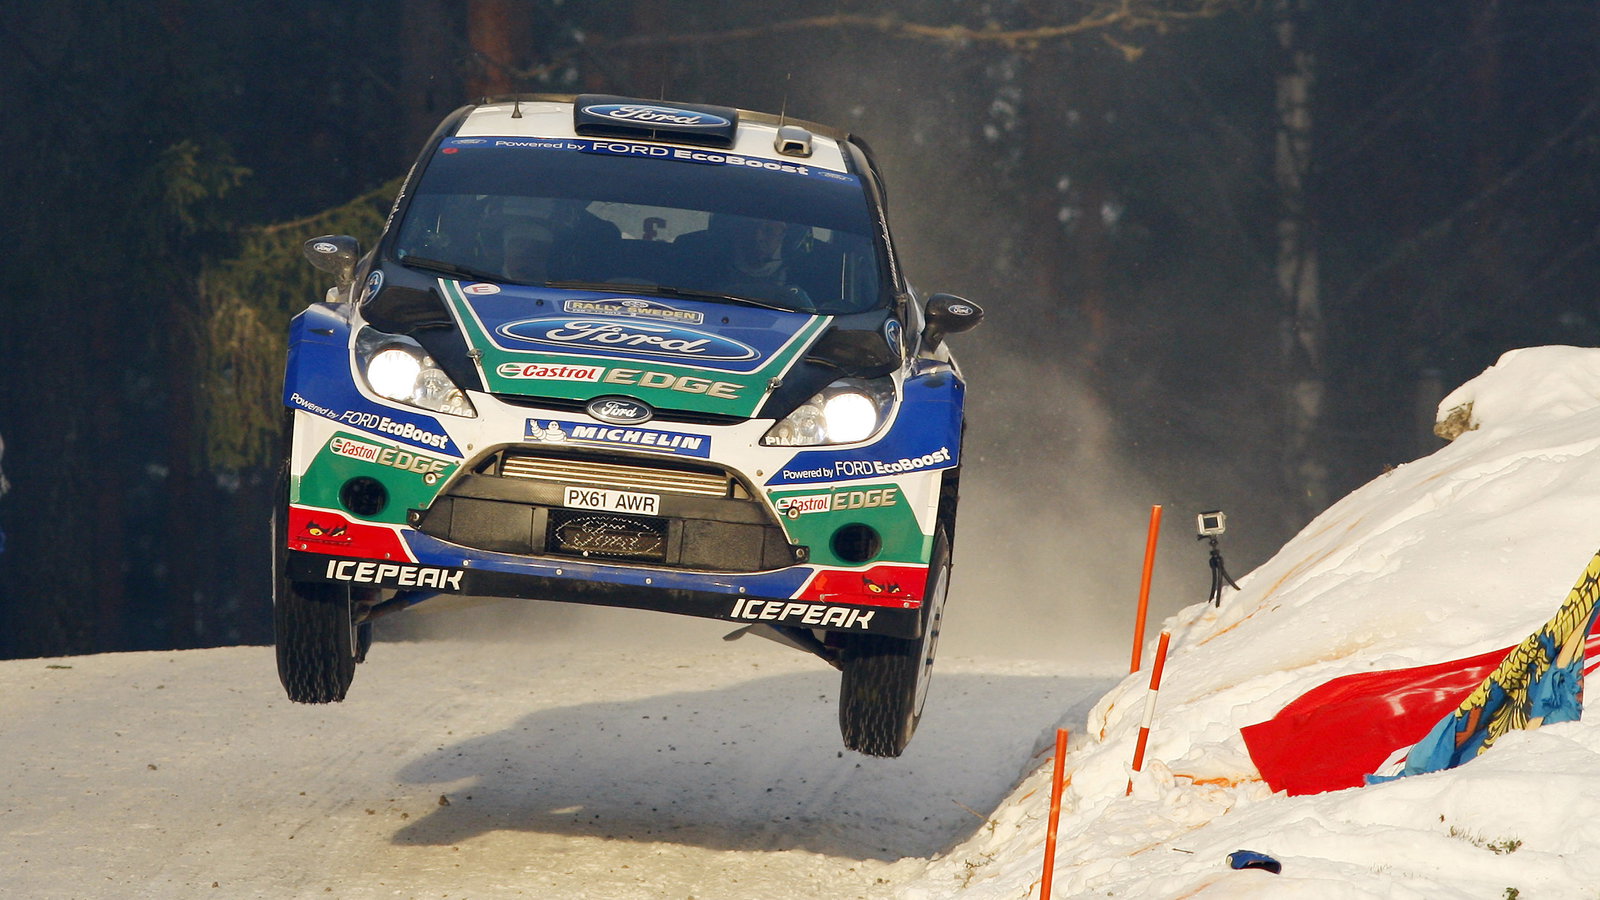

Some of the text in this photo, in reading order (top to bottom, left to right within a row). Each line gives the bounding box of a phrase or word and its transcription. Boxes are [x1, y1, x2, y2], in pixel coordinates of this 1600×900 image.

[609, 106, 702, 125] Ford
[495, 140, 562, 149] Powered
[567, 142, 586, 151] by
[592, 141, 669, 156] FORD
[674, 149, 809, 176] EcoBoost
[572, 302, 622, 312] RALLY
[627, 307, 696, 319] SWEDEN
[546, 319, 711, 355] Ford
[522, 364, 748, 400] Castrol EDGE
[290, 393, 449, 450] Powered by FORD EcoBoost
[599, 401, 637, 419] Ford
[571, 425, 703, 450] MICHELIN
[341, 441, 451, 479] Castrol EDGE
[783, 446, 951, 480] Powered by FORD EcoBoost
[568, 489, 655, 512] PX61 AWR
[831, 488, 898, 511] EDGE
[326, 559, 465, 591] ICEPEAK
[730, 598, 876, 630] ICEPEAK
